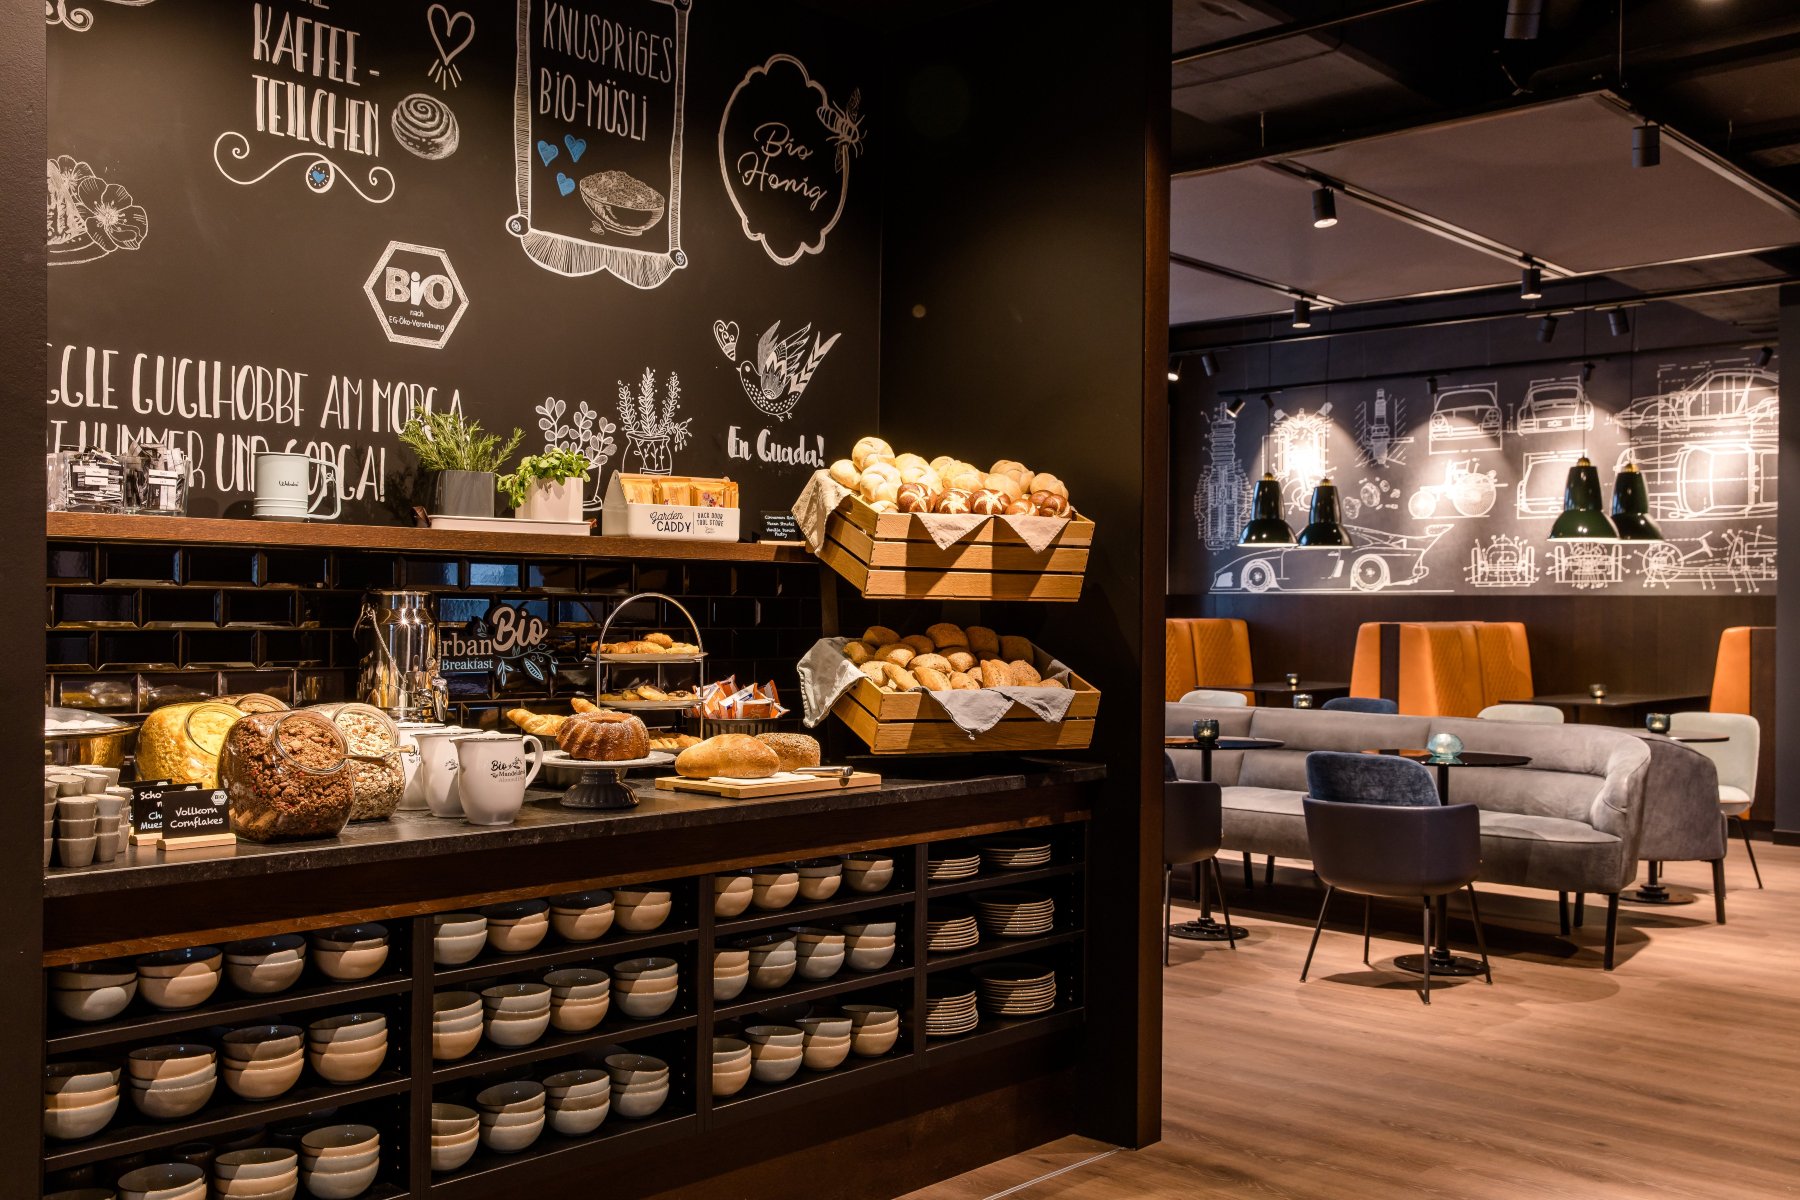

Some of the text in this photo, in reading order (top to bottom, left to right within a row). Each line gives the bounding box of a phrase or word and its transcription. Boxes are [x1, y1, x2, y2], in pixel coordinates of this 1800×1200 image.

[252, 74, 379, 158] TEILCHEN
[753, 121, 814, 161] Bio
[737, 151, 828, 212] Honig
[409, 309, 424, 318] nach
[320, 374, 363, 431] AM
[727, 425, 825, 468] En Guada!
[285, 439, 386, 503] ORGA!
[650, 511, 684, 525] Garden
[656, 520, 692, 533] CADDY
[441, 606, 549, 657] rban Bio
[441, 656, 494, 671] Breakfast
[490, 759, 507, 772] Bio
[139, 790, 164, 801] Scho
[175, 806, 218, 818] Vollkorn
[170, 816, 224, 829] Cornflakes
